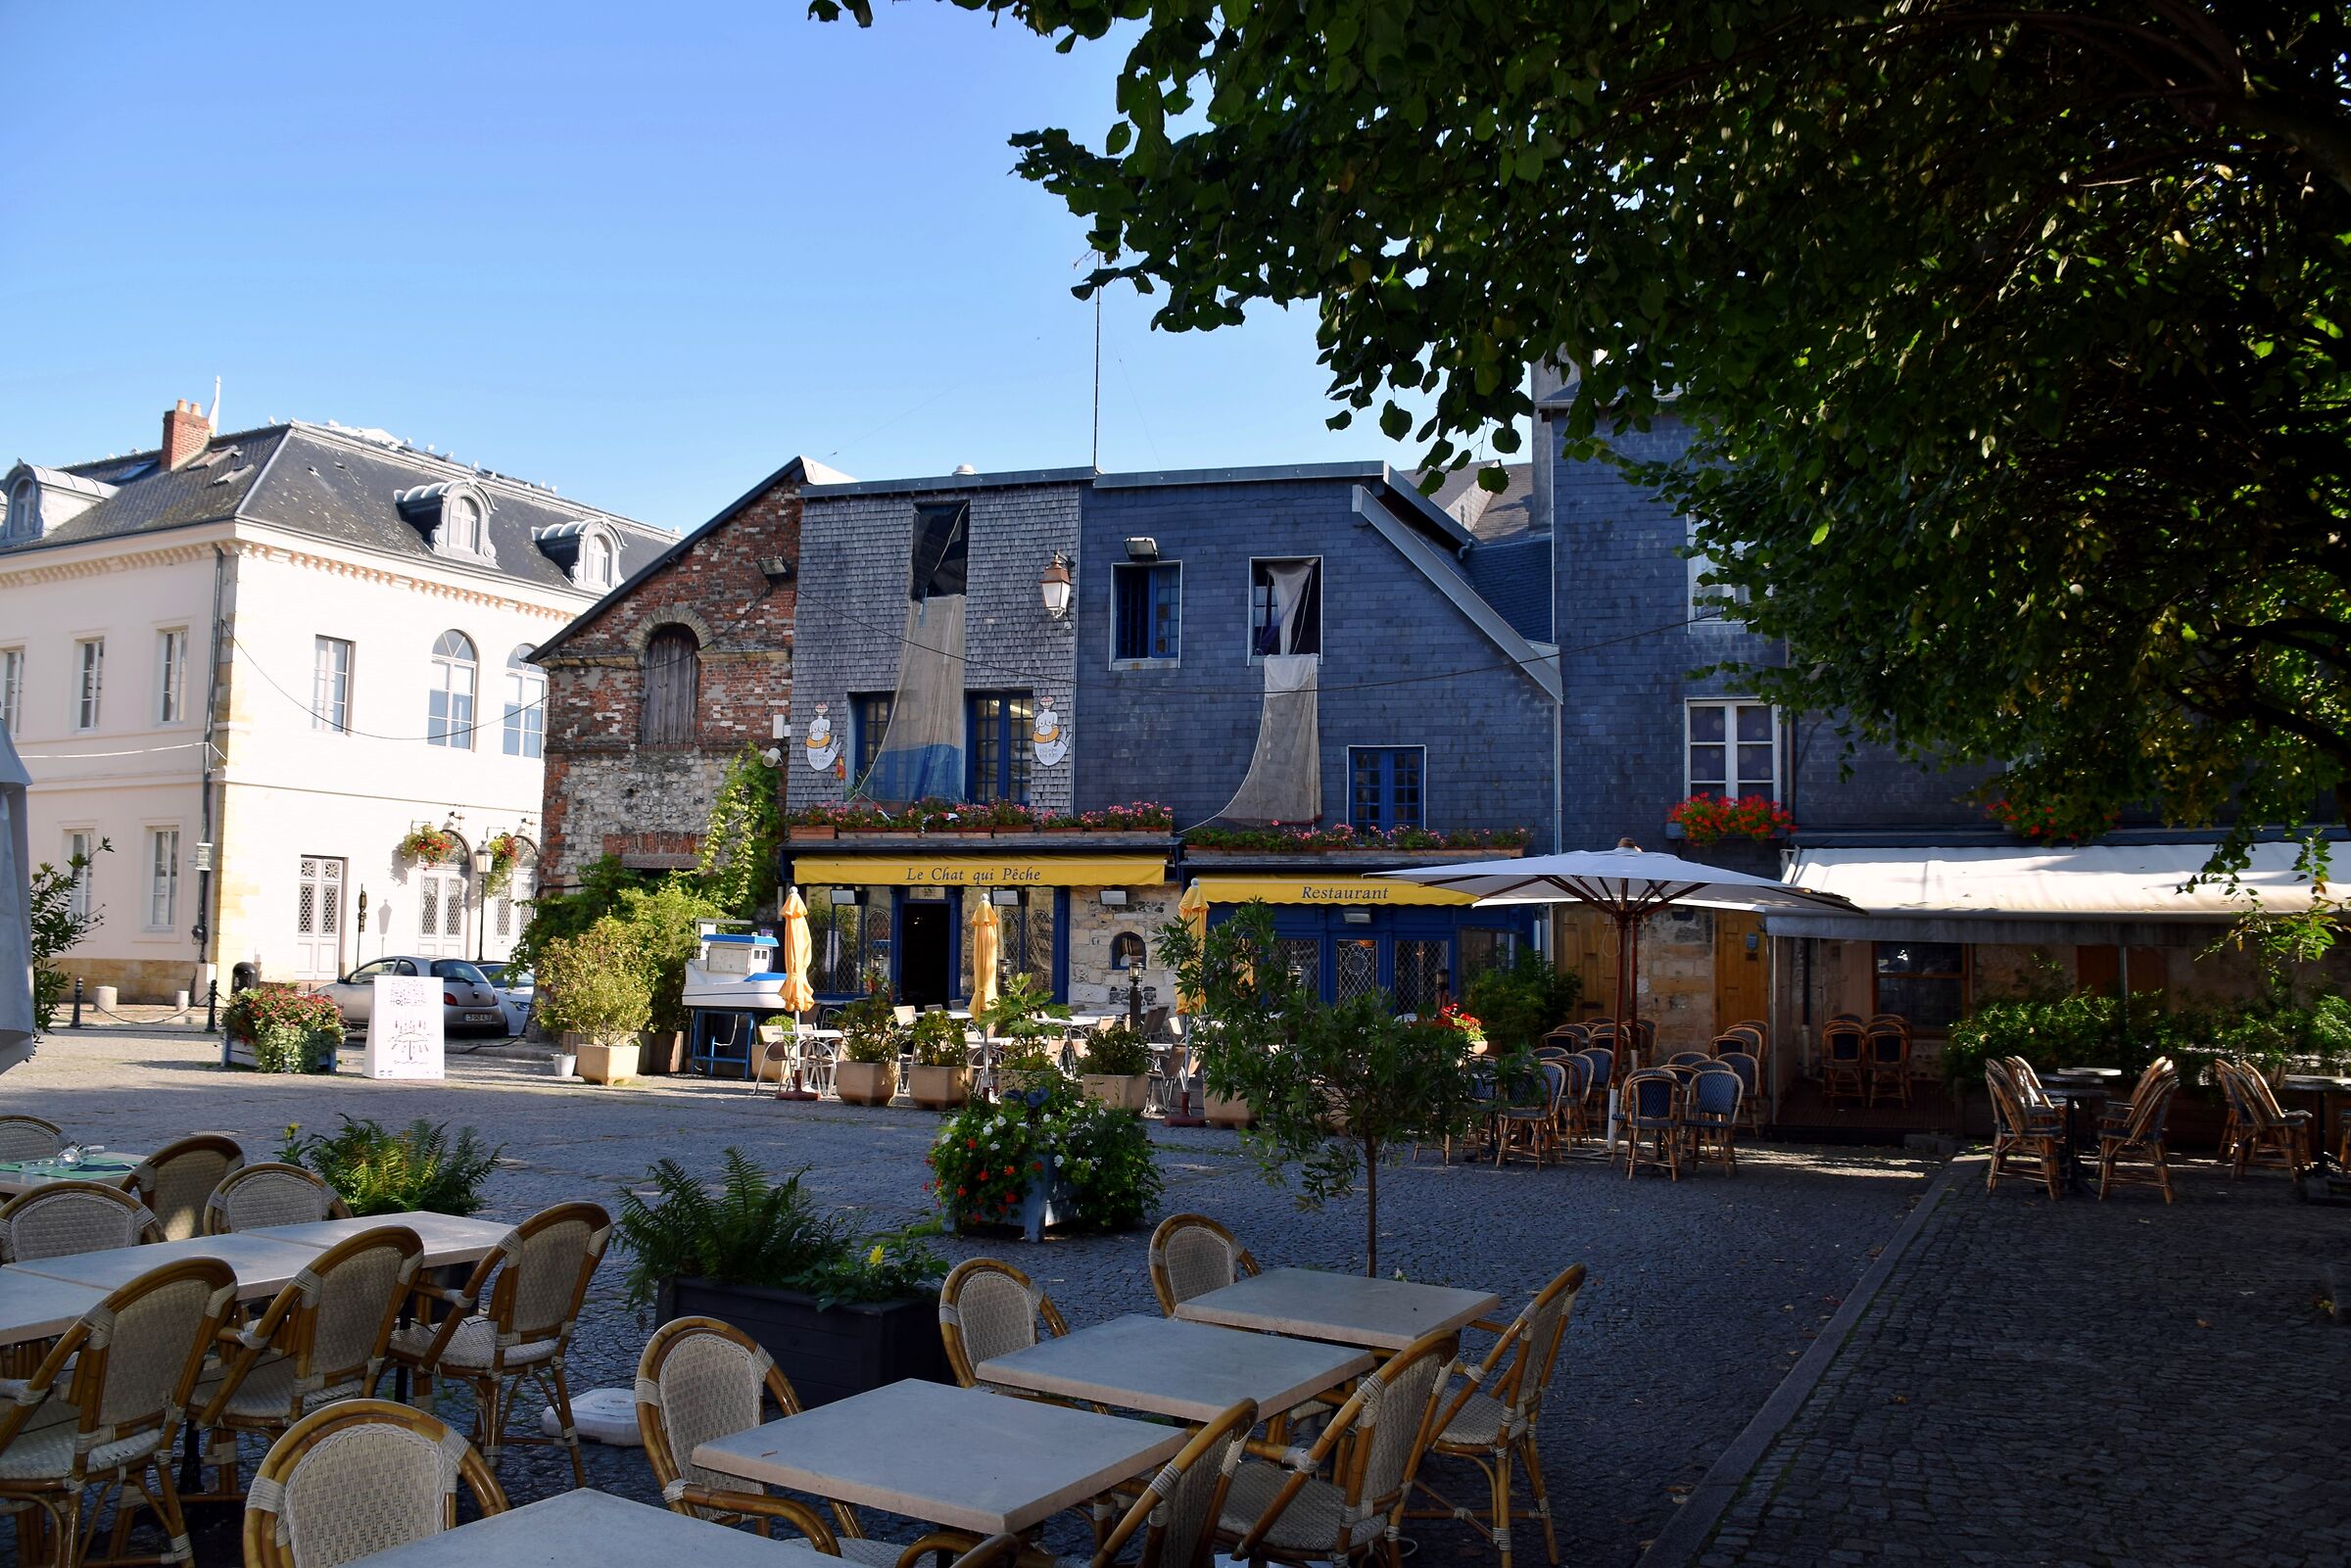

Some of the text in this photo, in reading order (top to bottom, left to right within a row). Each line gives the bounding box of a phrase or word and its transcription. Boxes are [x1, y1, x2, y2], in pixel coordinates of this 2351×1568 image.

[906, 866, 1041, 885] Le Chat qui Pêche
[1302, 885, 1389, 899] Restaurant
